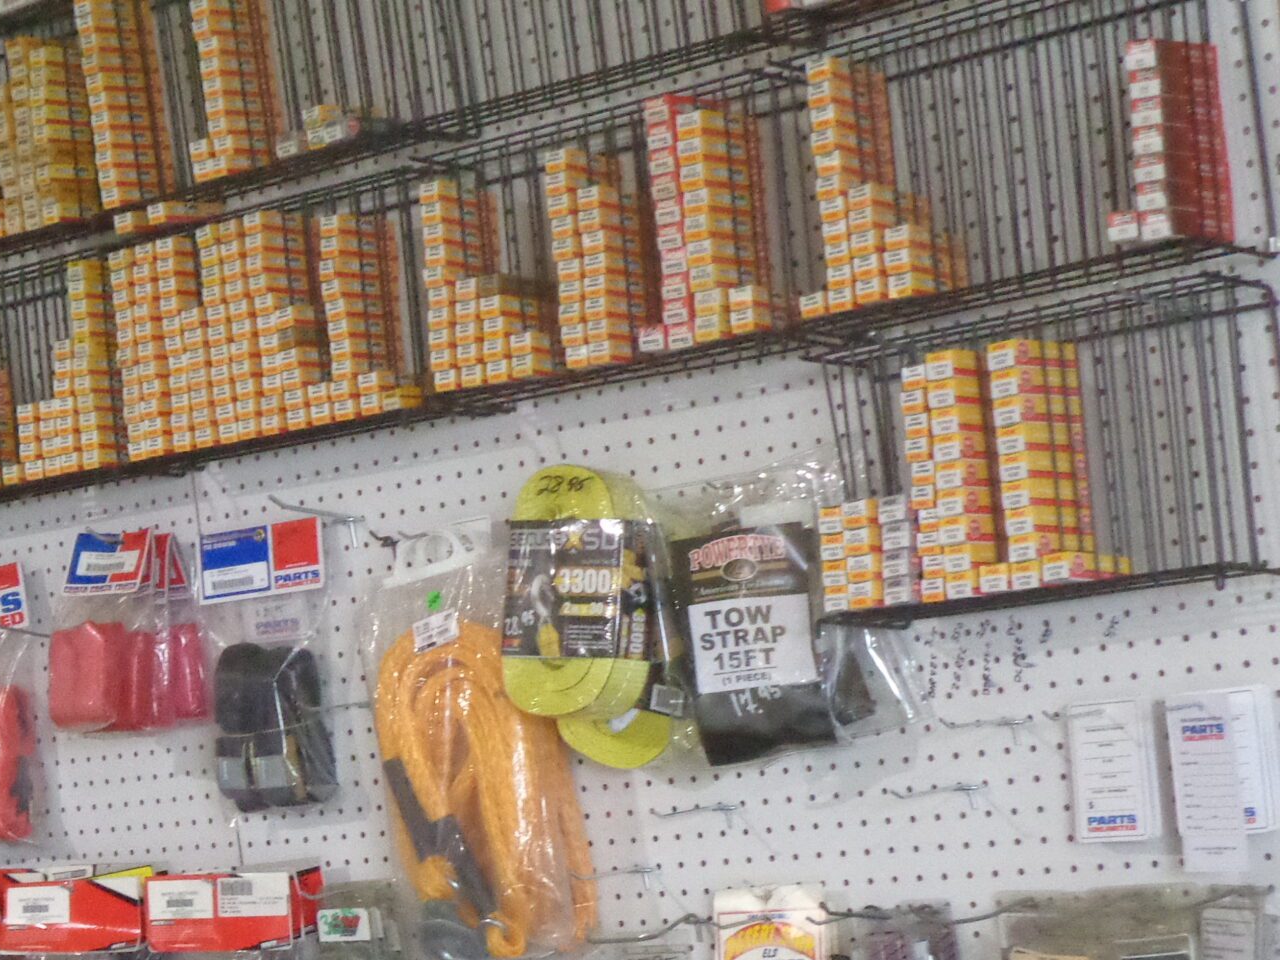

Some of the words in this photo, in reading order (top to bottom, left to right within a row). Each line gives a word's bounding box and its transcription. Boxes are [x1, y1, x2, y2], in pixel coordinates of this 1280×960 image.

[274, 569, 320, 584] PARTS
[558, 568, 611, 593] 3300
[704, 604, 773, 630] TOW
[700, 626, 786, 651] STRAP
[714, 647, 776, 670] 15FT
[1182, 723, 1224, 735] PARTS
[1087, 814, 1137, 826] PARTS
